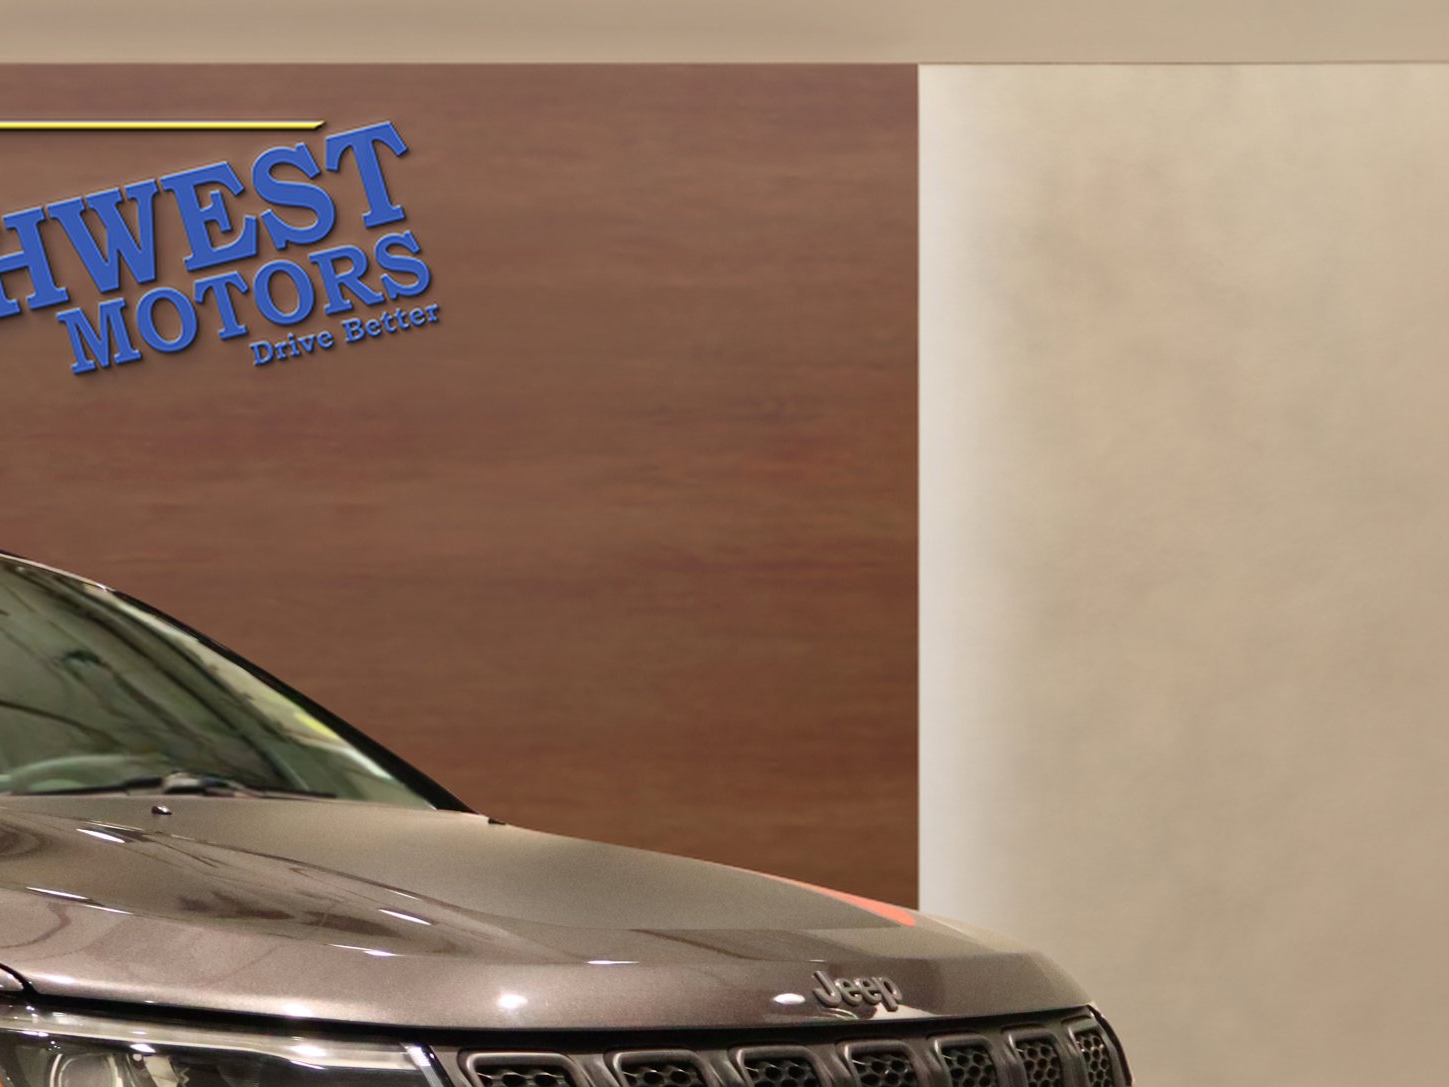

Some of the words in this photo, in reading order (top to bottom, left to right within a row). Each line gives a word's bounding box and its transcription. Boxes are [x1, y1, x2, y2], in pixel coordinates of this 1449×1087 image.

[56, 231, 431, 374] MOTORS
[250, 333, 335, 366] Drive
[342, 304, 440, 343] Better
[812, 970, 903, 1012] Jeep
